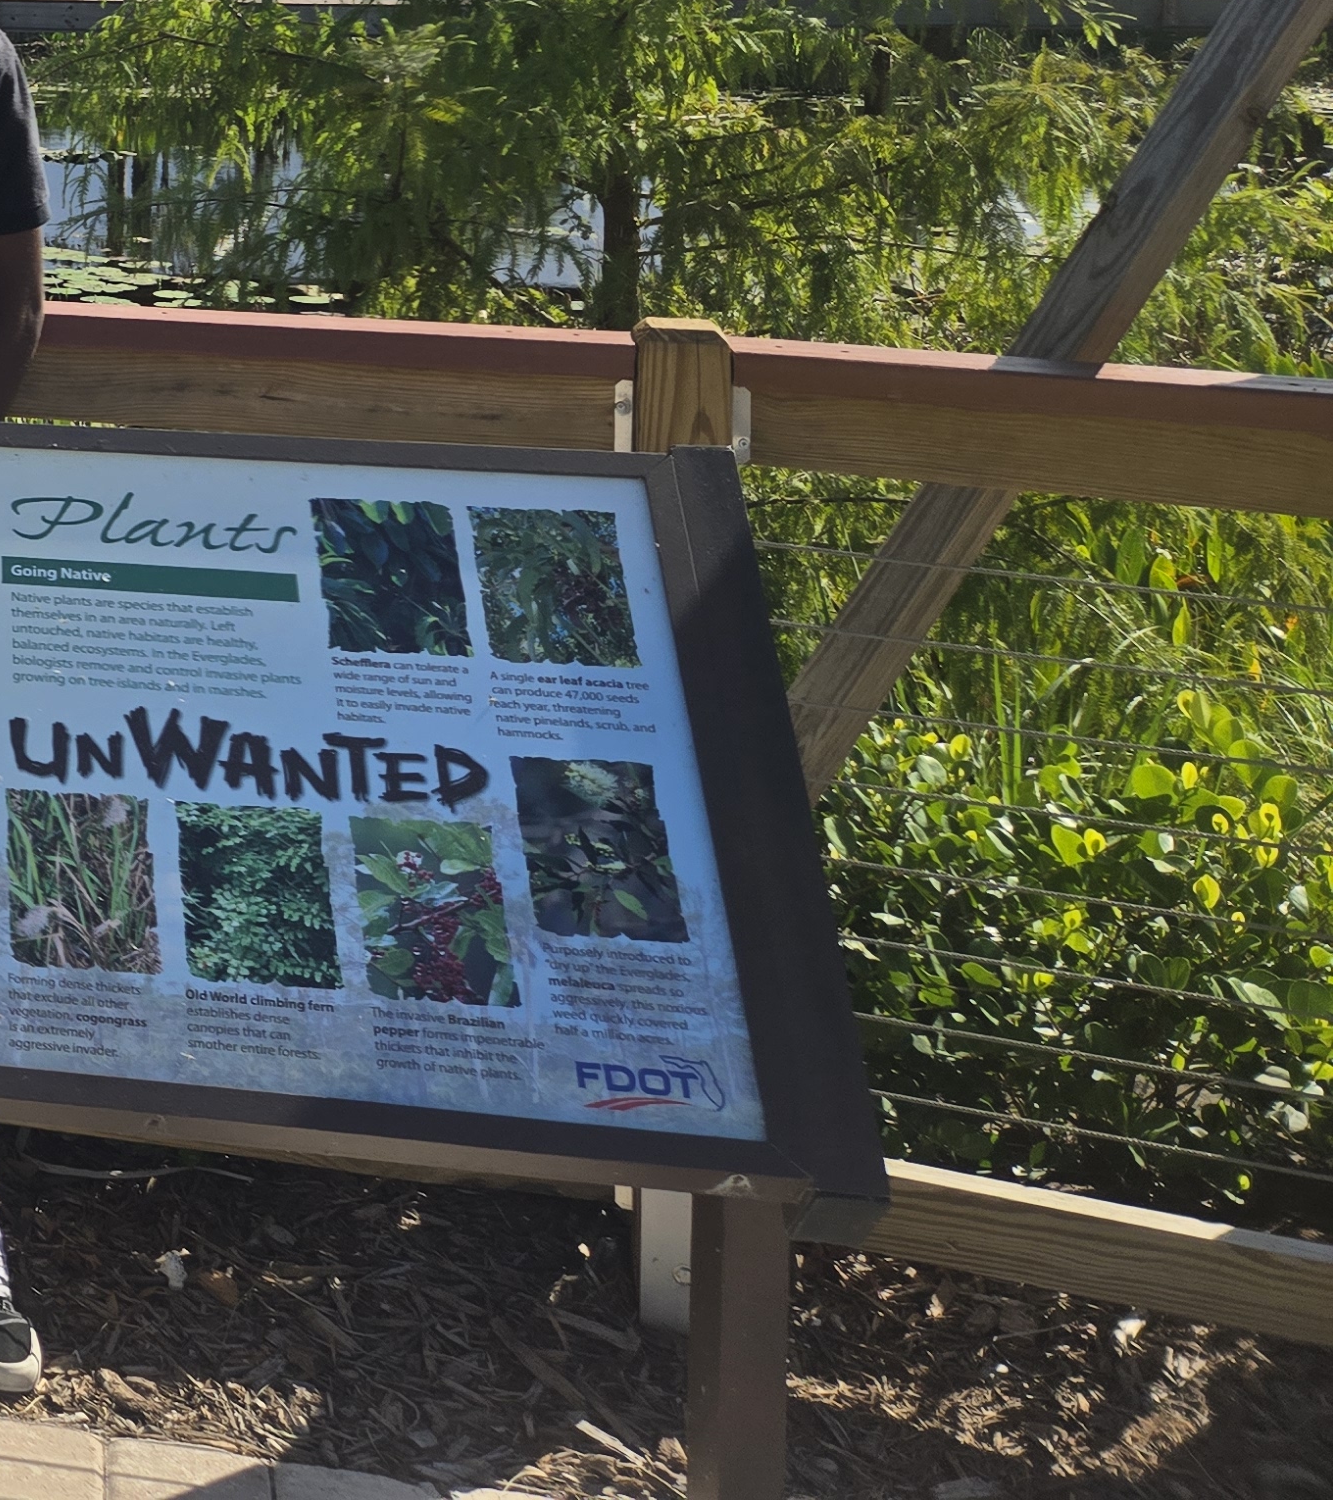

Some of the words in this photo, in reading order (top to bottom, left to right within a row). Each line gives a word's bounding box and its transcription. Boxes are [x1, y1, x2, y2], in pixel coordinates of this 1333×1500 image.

[11, 492, 298, 553] Plants
[10, 564, 57, 583] Going
[60, 567, 112, 583] Native
[185, 989, 208, 1001] Old
[209, 991, 247, 1005] World
[249, 995, 306, 1013] climbing
[307, 999, 335, 1012] fern
[575, 1060, 701, 1099] FDOT
